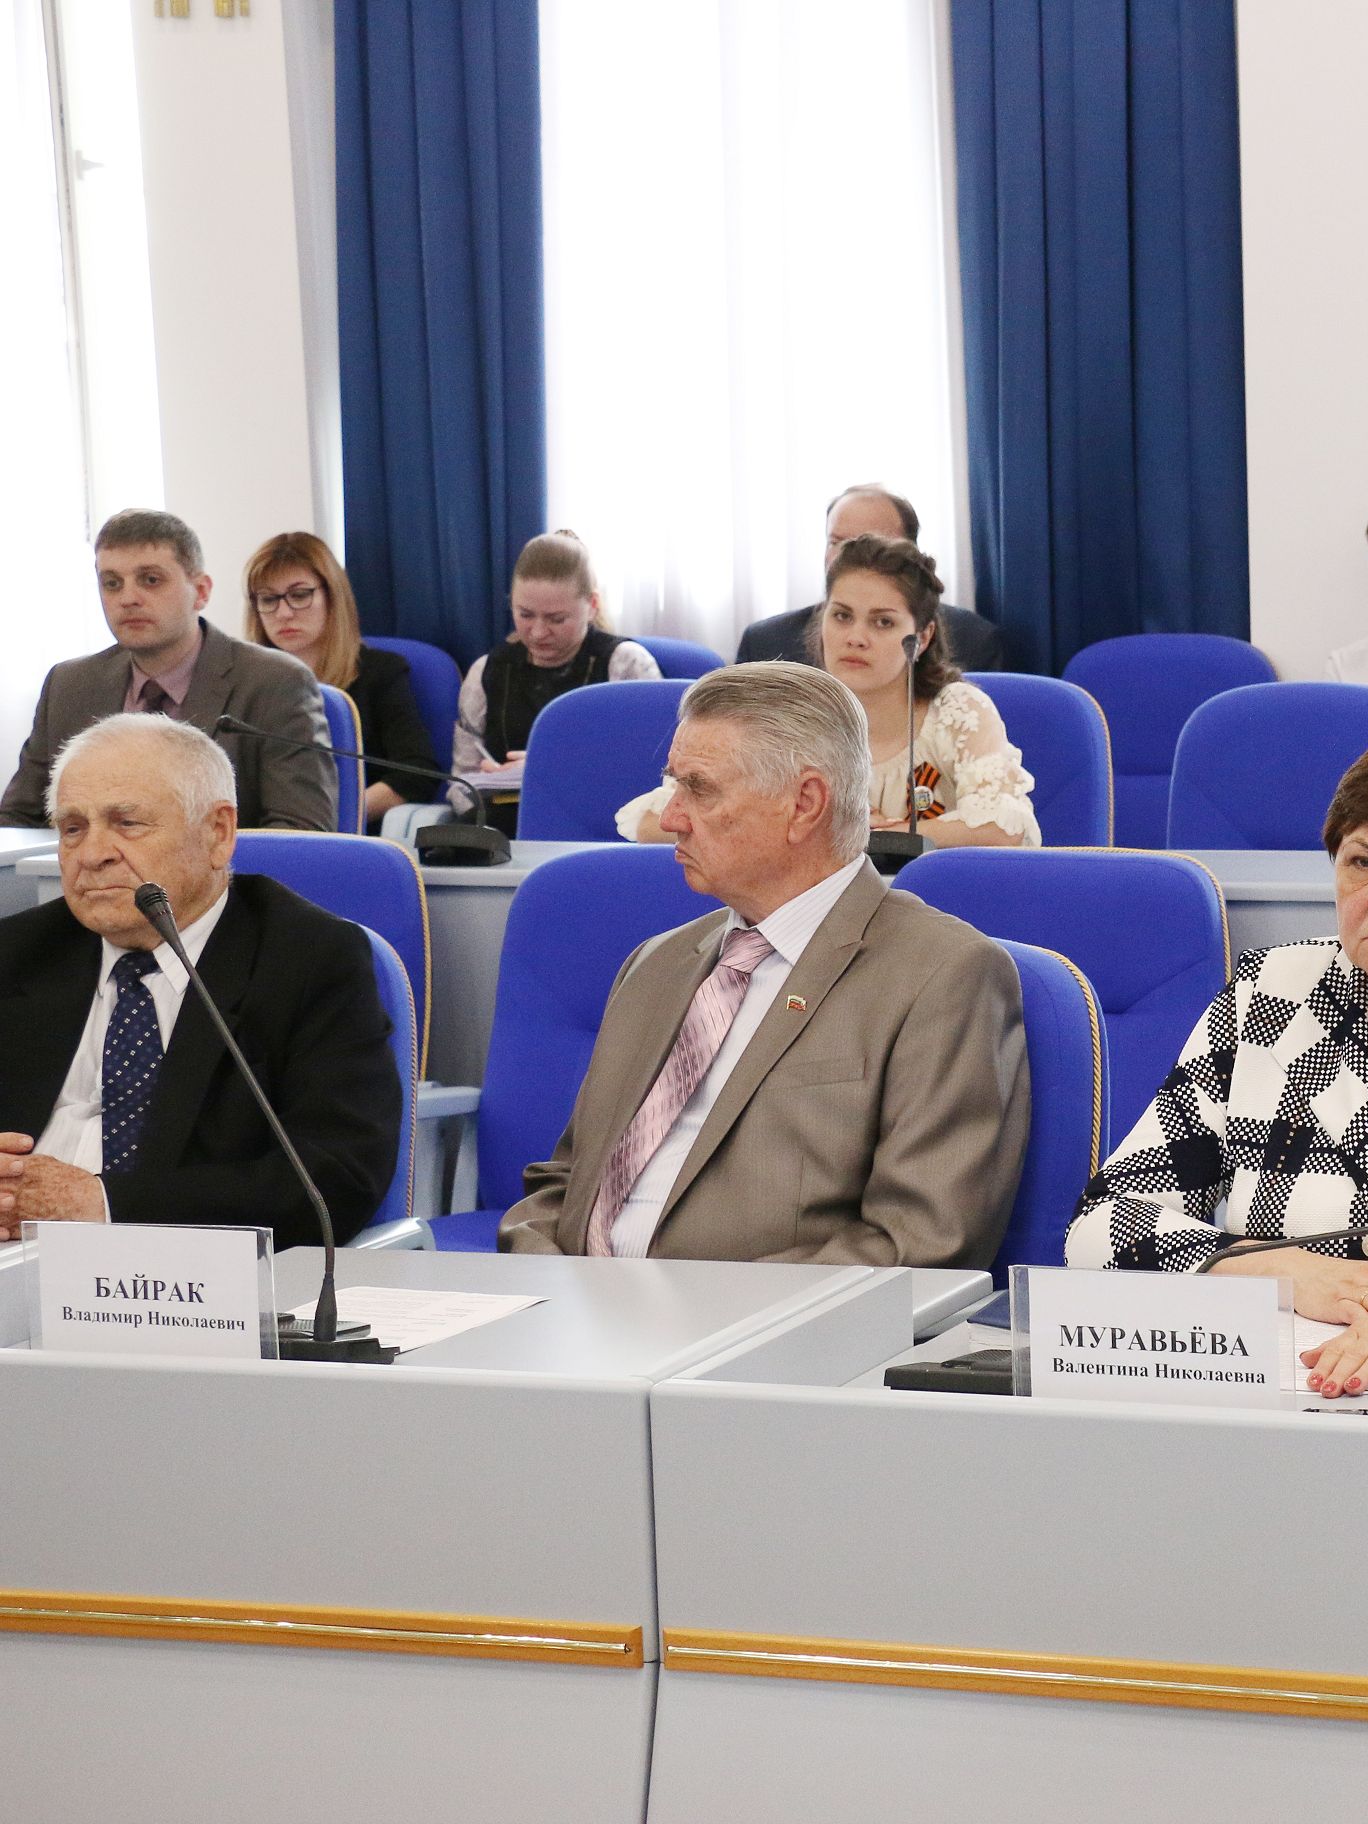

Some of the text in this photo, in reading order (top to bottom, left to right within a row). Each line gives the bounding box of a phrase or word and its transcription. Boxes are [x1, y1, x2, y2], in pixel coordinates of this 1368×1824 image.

[94, 1273, 205, 1304] БАЙРАК
[62, 1306, 246, 1331] Владимир Николаевич
[1059, 1324, 1250, 1357] МУРАВЬЁВА
[1052, 1357, 1266, 1384] Валентина Николаевна
